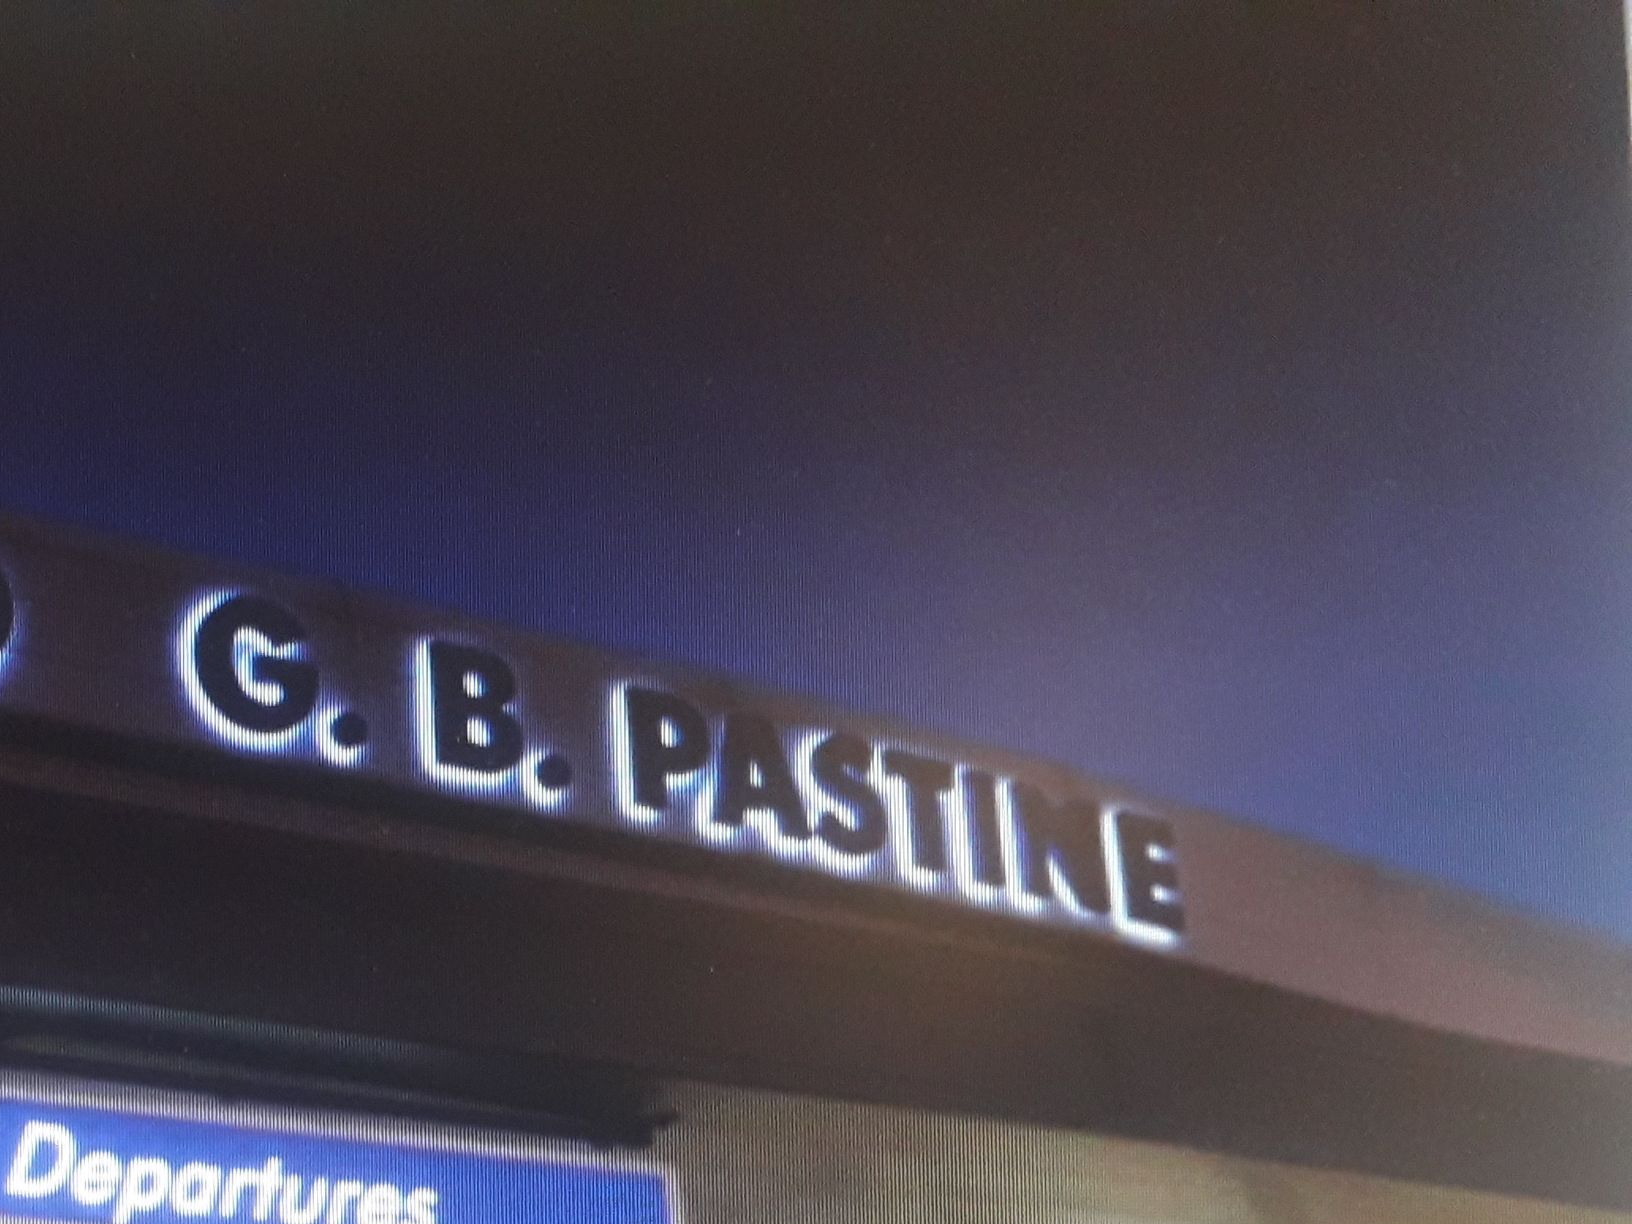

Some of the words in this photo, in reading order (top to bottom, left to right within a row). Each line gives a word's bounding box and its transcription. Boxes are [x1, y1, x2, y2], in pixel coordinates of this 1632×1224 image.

[180, 590, 367, 765] G.
[416, 637, 571, 810] B.
[611, 680, 1184, 945] PASTINE
